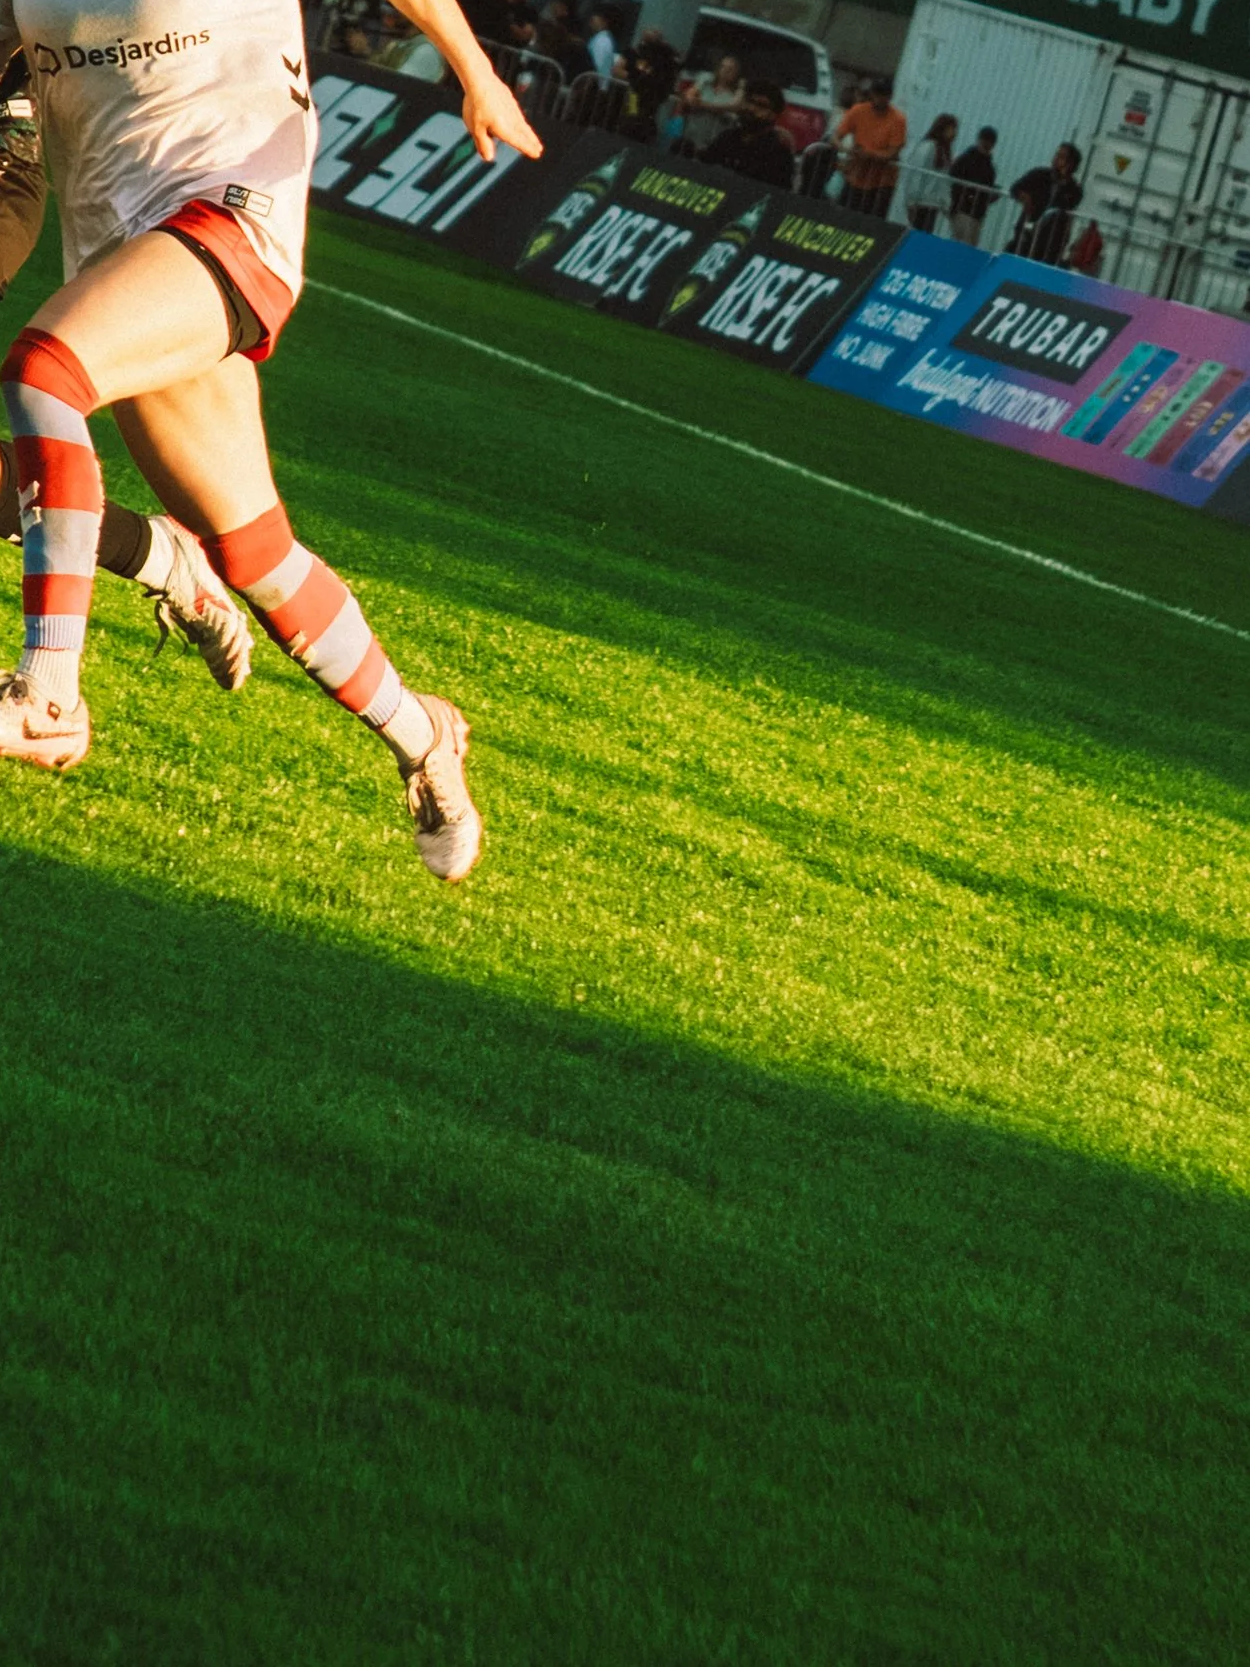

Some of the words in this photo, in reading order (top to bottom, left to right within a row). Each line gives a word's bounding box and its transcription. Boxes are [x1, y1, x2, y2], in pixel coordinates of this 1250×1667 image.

[63, 29, 211, 70] Desjardins
[629, 167, 726, 216] VANCOUVER
[553, 205, 660, 285] RISE
[602, 224, 693, 301] FC
[773, 214, 875, 262] VANCOUVER
[698, 254, 805, 341] RISE
[754, 272, 840, 352] FC
[856, 301, 899, 330] HIGH
[901, 273, 962, 312] PROTEIN
[832, 333, 862, 361] NO
[851, 340, 895, 371] JUNK
[971, 295, 1109, 369] TRUBAR
[969, 377, 1072, 433] NUTRITION
